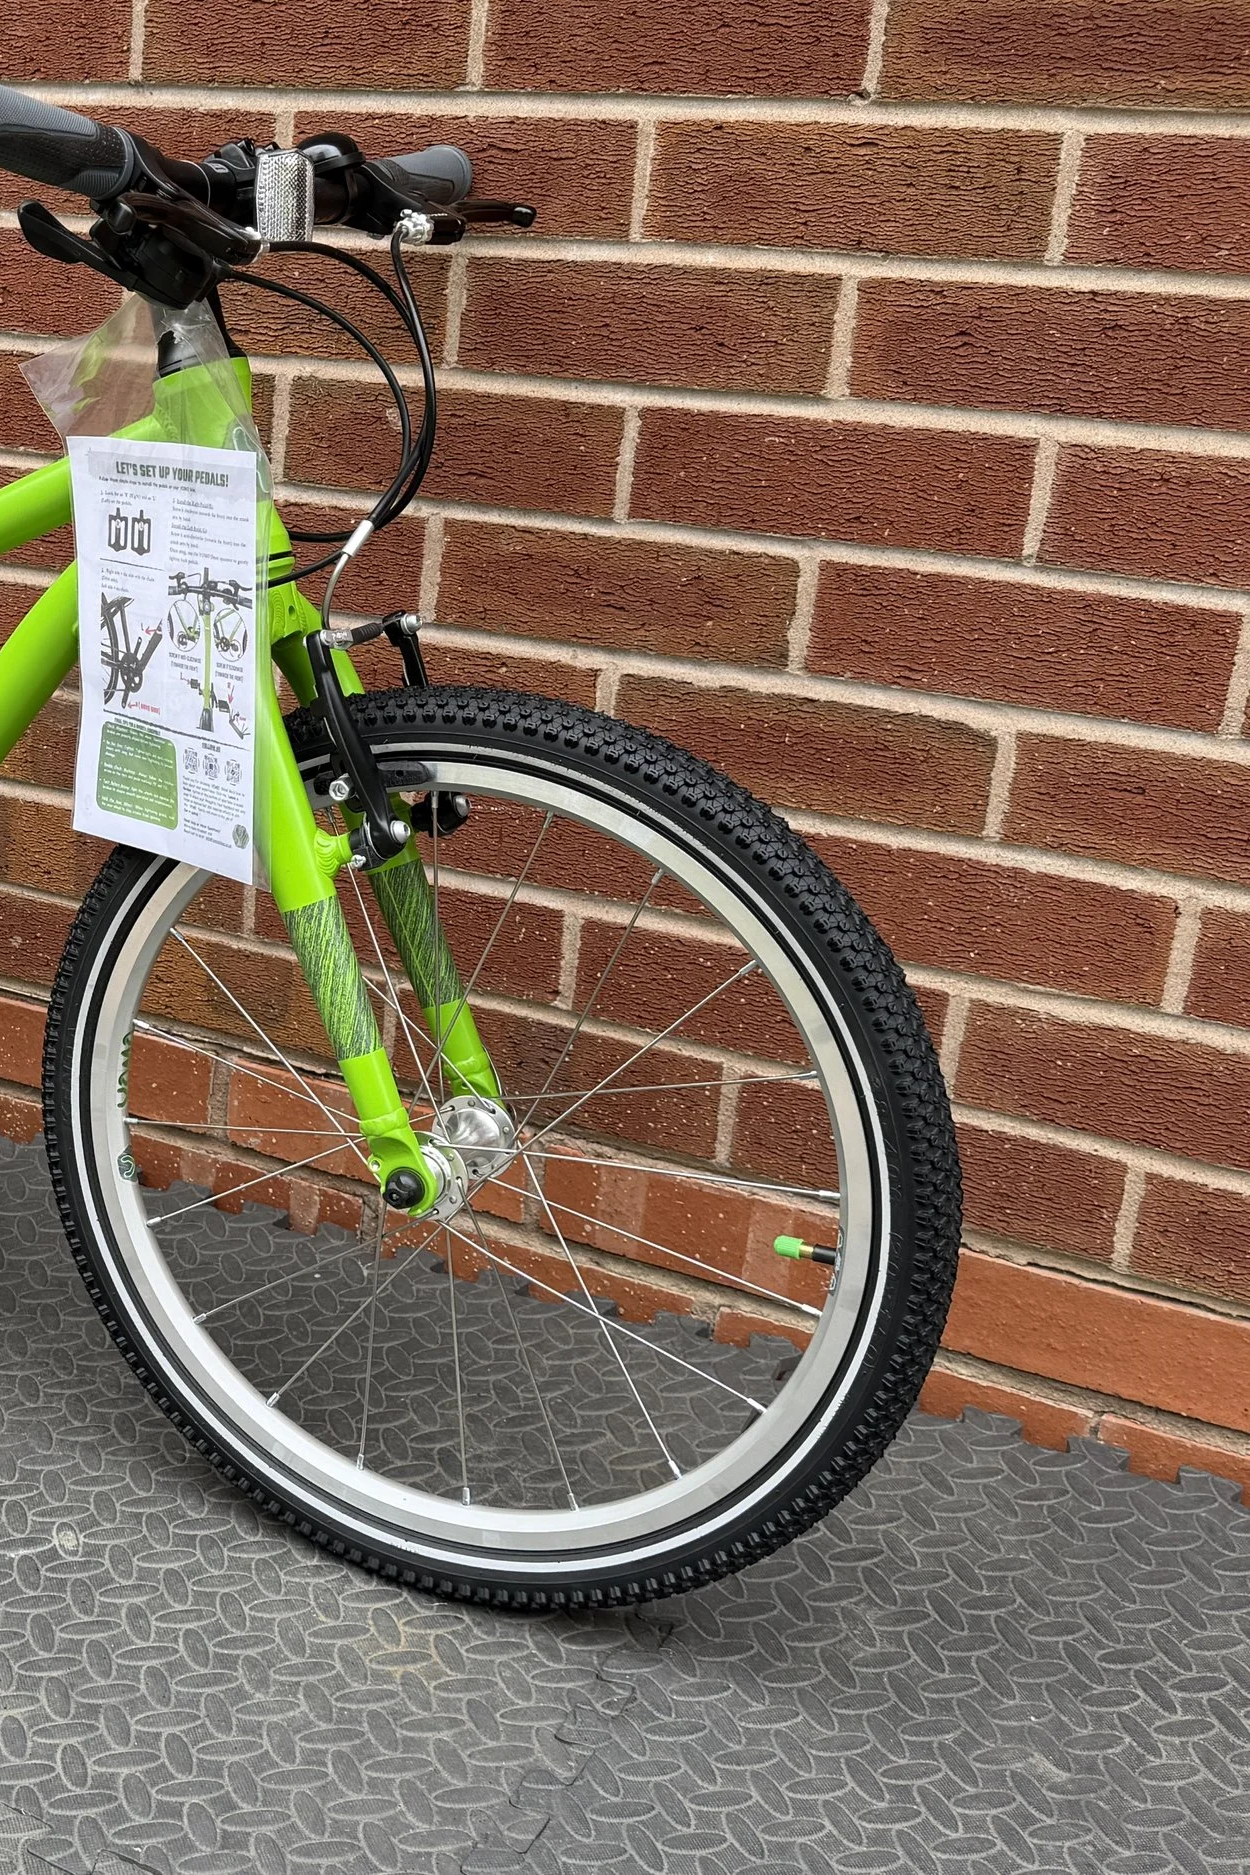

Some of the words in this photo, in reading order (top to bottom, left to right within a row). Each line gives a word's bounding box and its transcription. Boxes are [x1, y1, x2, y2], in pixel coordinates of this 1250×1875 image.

[116, 461, 138, 476] LET'S
[139, 464, 157, 478] SET
[159, 465, 171, 479] UP
[172, 467, 193, 482] YOUR
[195, 470, 229, 487] PEDALS!
